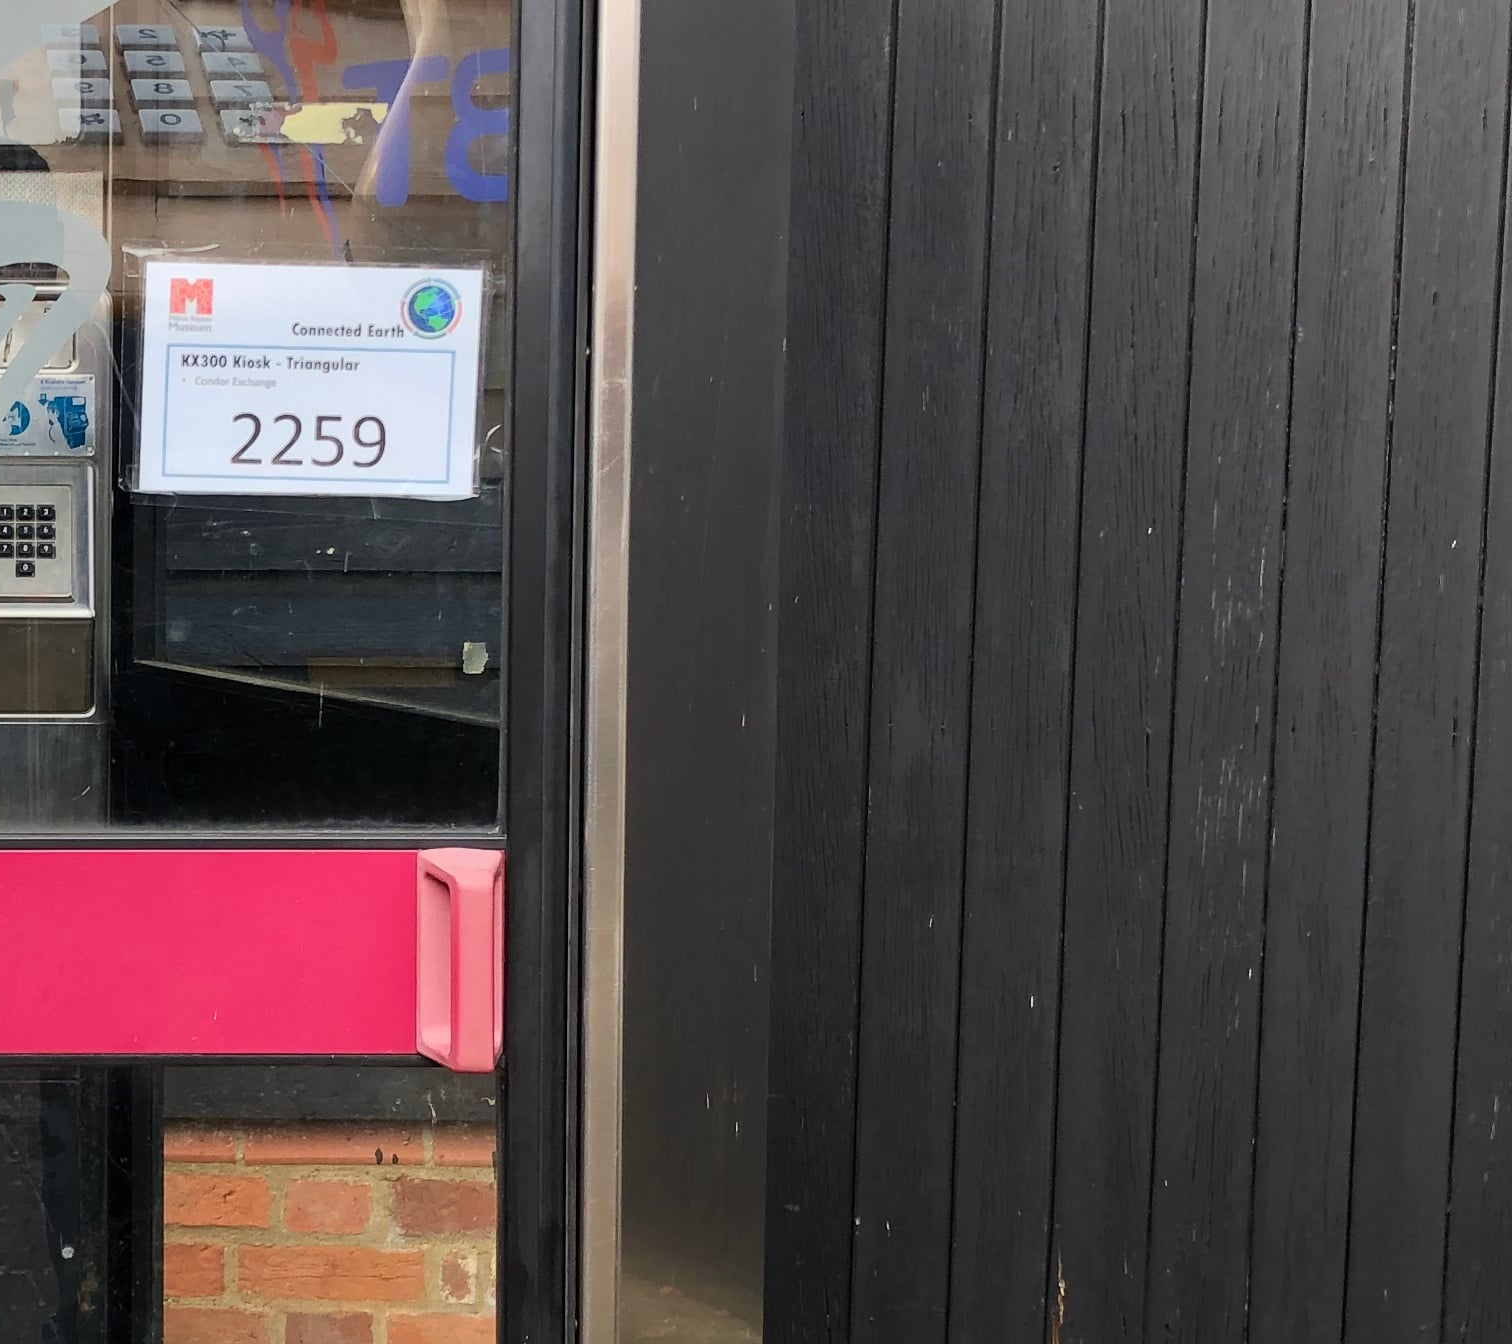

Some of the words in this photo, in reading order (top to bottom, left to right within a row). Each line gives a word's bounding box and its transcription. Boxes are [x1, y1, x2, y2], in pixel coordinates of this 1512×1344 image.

[170, 277, 214, 315] M
[168, 321, 212, 333] Museum
[292, 321, 362, 338] Connected
[367, 323, 404, 339] Earth
[181, 353, 228, 368] KX300
[233, 355, 271, 370] Kiosk
[286, 356, 361, 374] Triangular
[194, 375, 230, 387] Condor
[231, 376, 277, 389] Exchange
[230, 412, 387, 469] 2259
